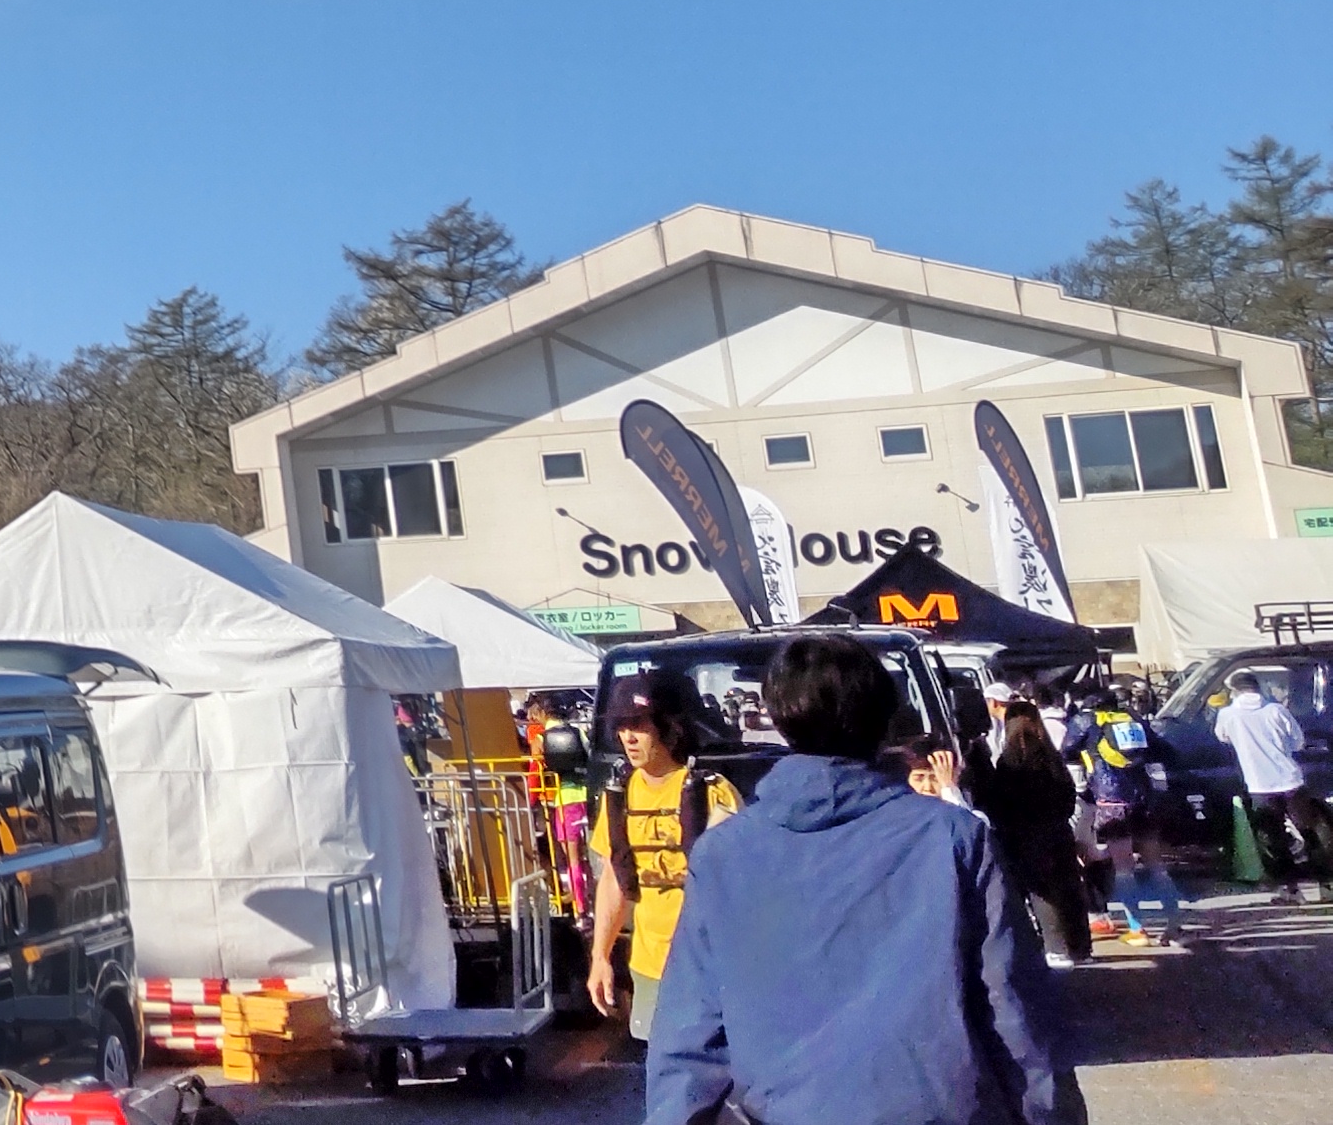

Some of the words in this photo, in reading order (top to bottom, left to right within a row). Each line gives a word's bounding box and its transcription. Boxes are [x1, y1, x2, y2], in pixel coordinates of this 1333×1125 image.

[787, 524, 943, 569] ouse
[581, 610, 627, 622] ロッカー
